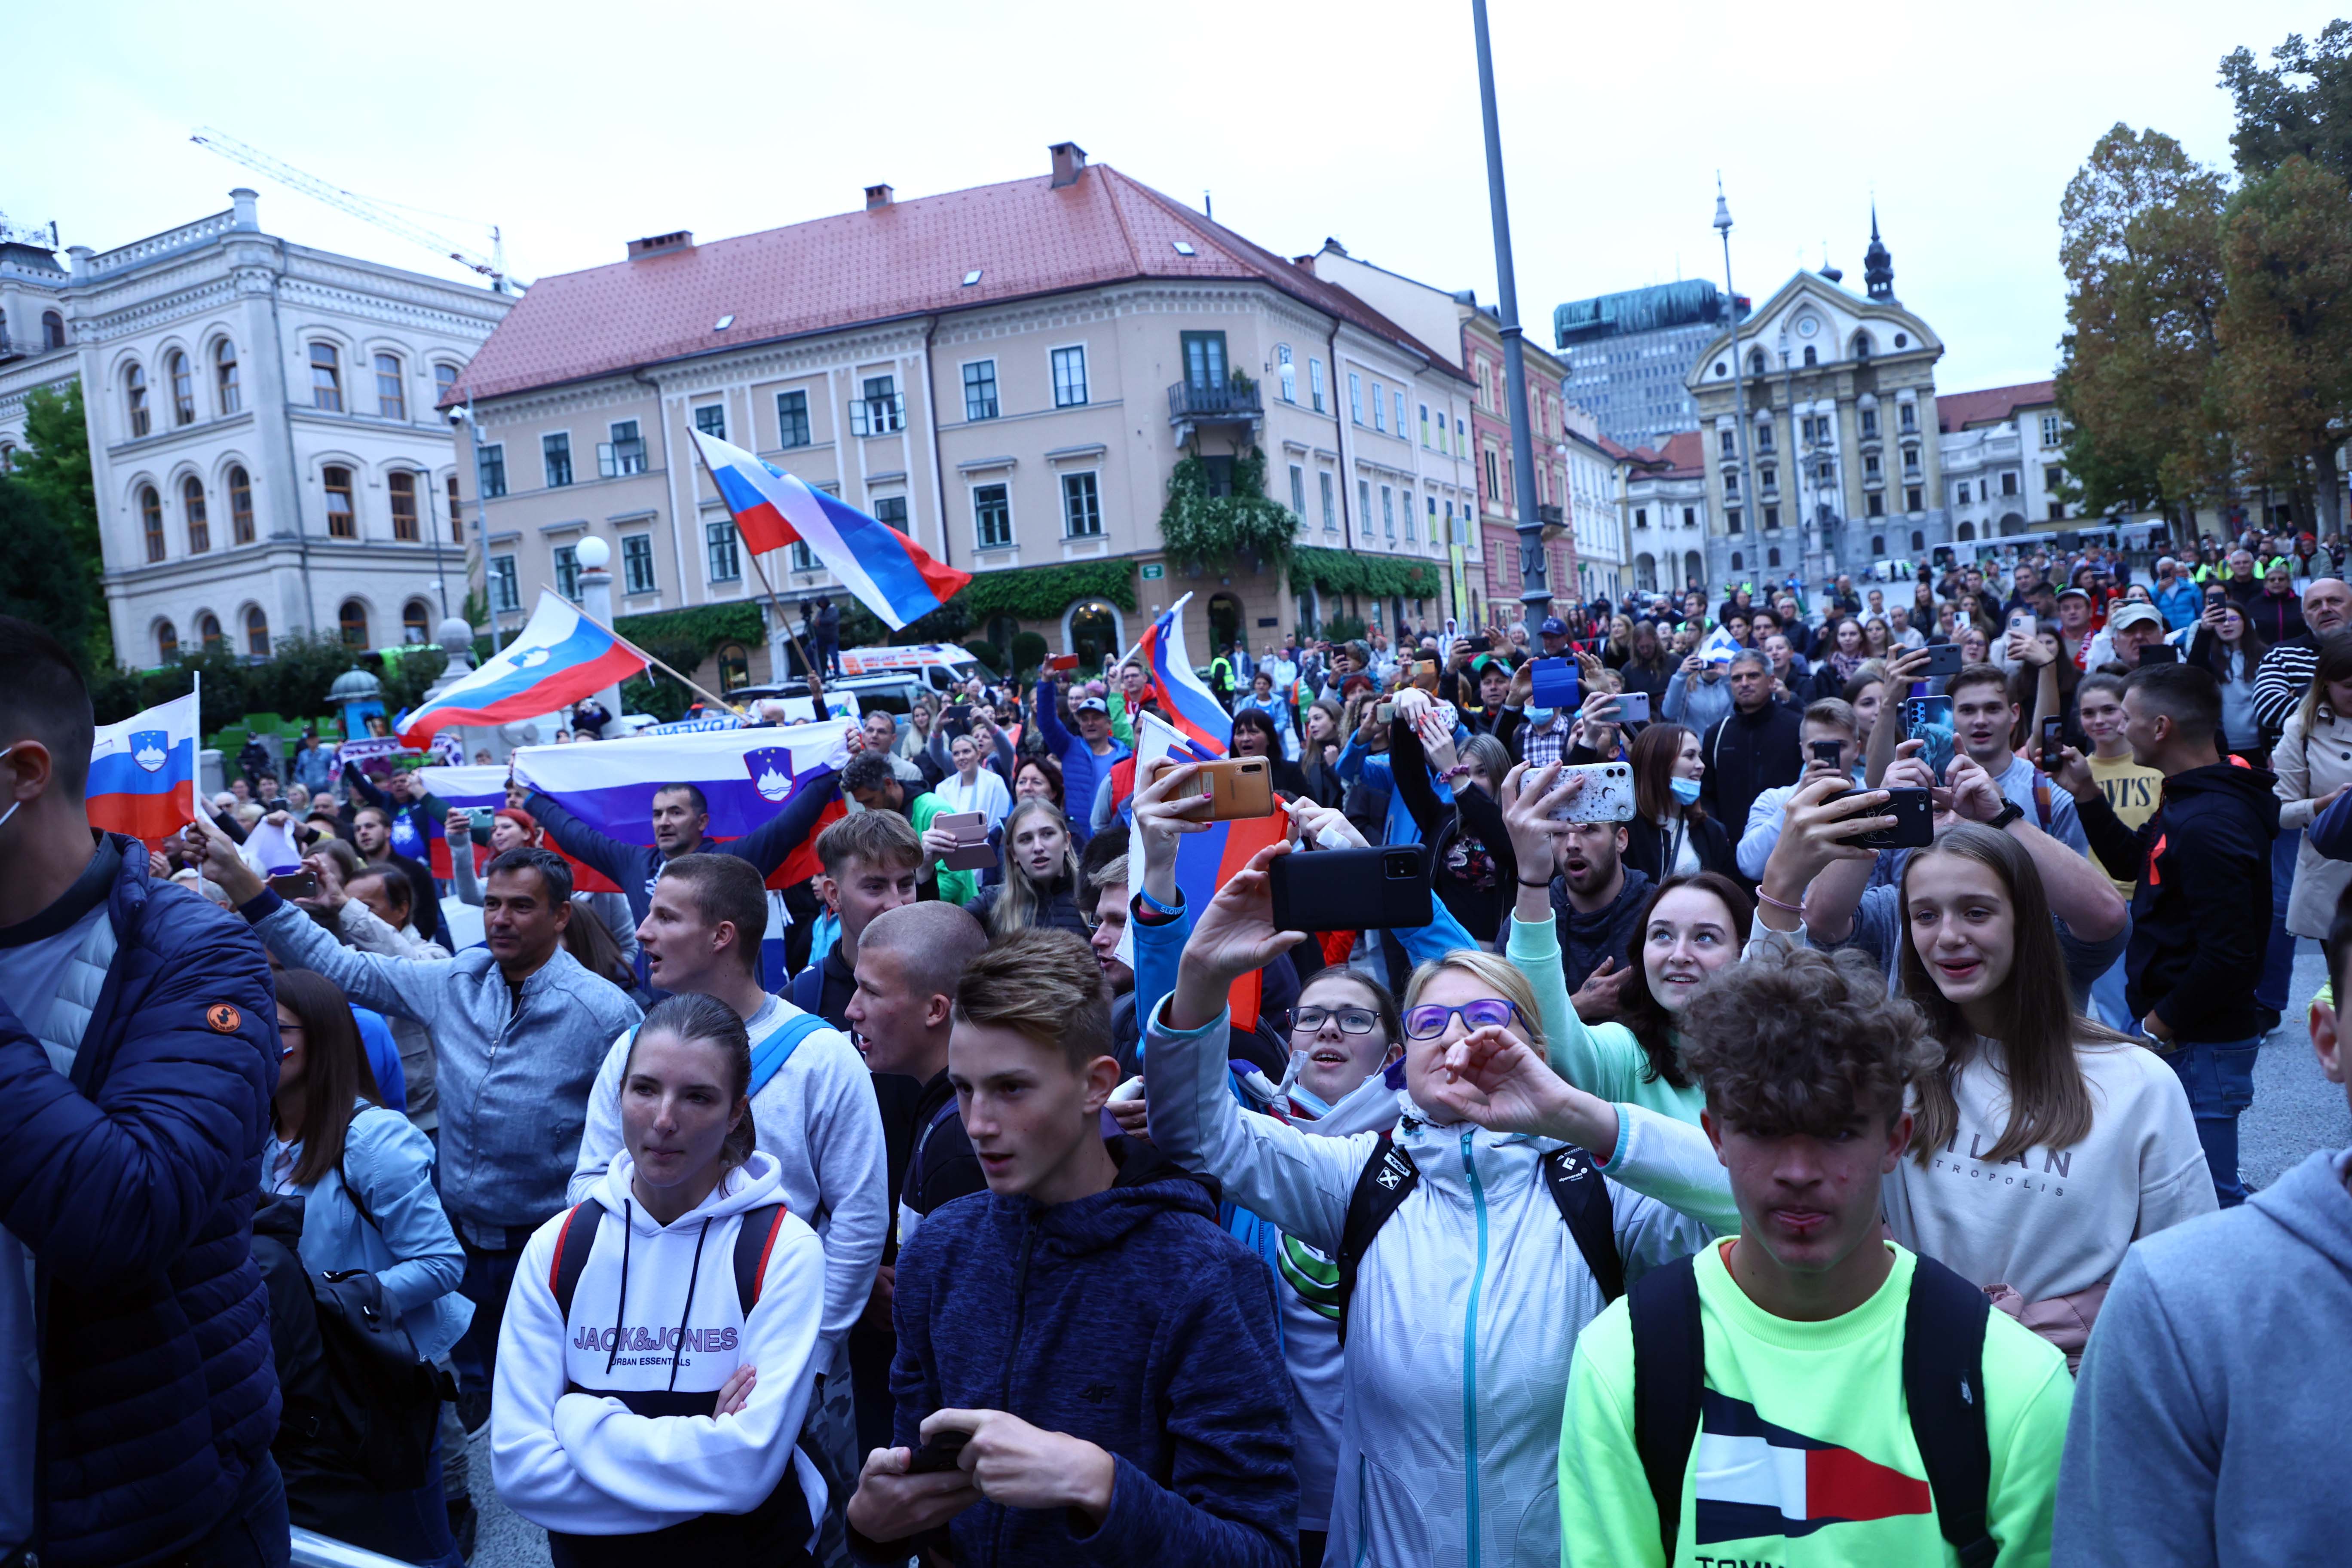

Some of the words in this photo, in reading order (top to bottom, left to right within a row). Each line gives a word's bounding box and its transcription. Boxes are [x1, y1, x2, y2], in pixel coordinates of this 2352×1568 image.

[2097, 776, 2151, 807] VI'S
[1902, 1148, 2064, 1197] MTROPOLIS
[574, 1326, 738, 1353] JACK&JONES
